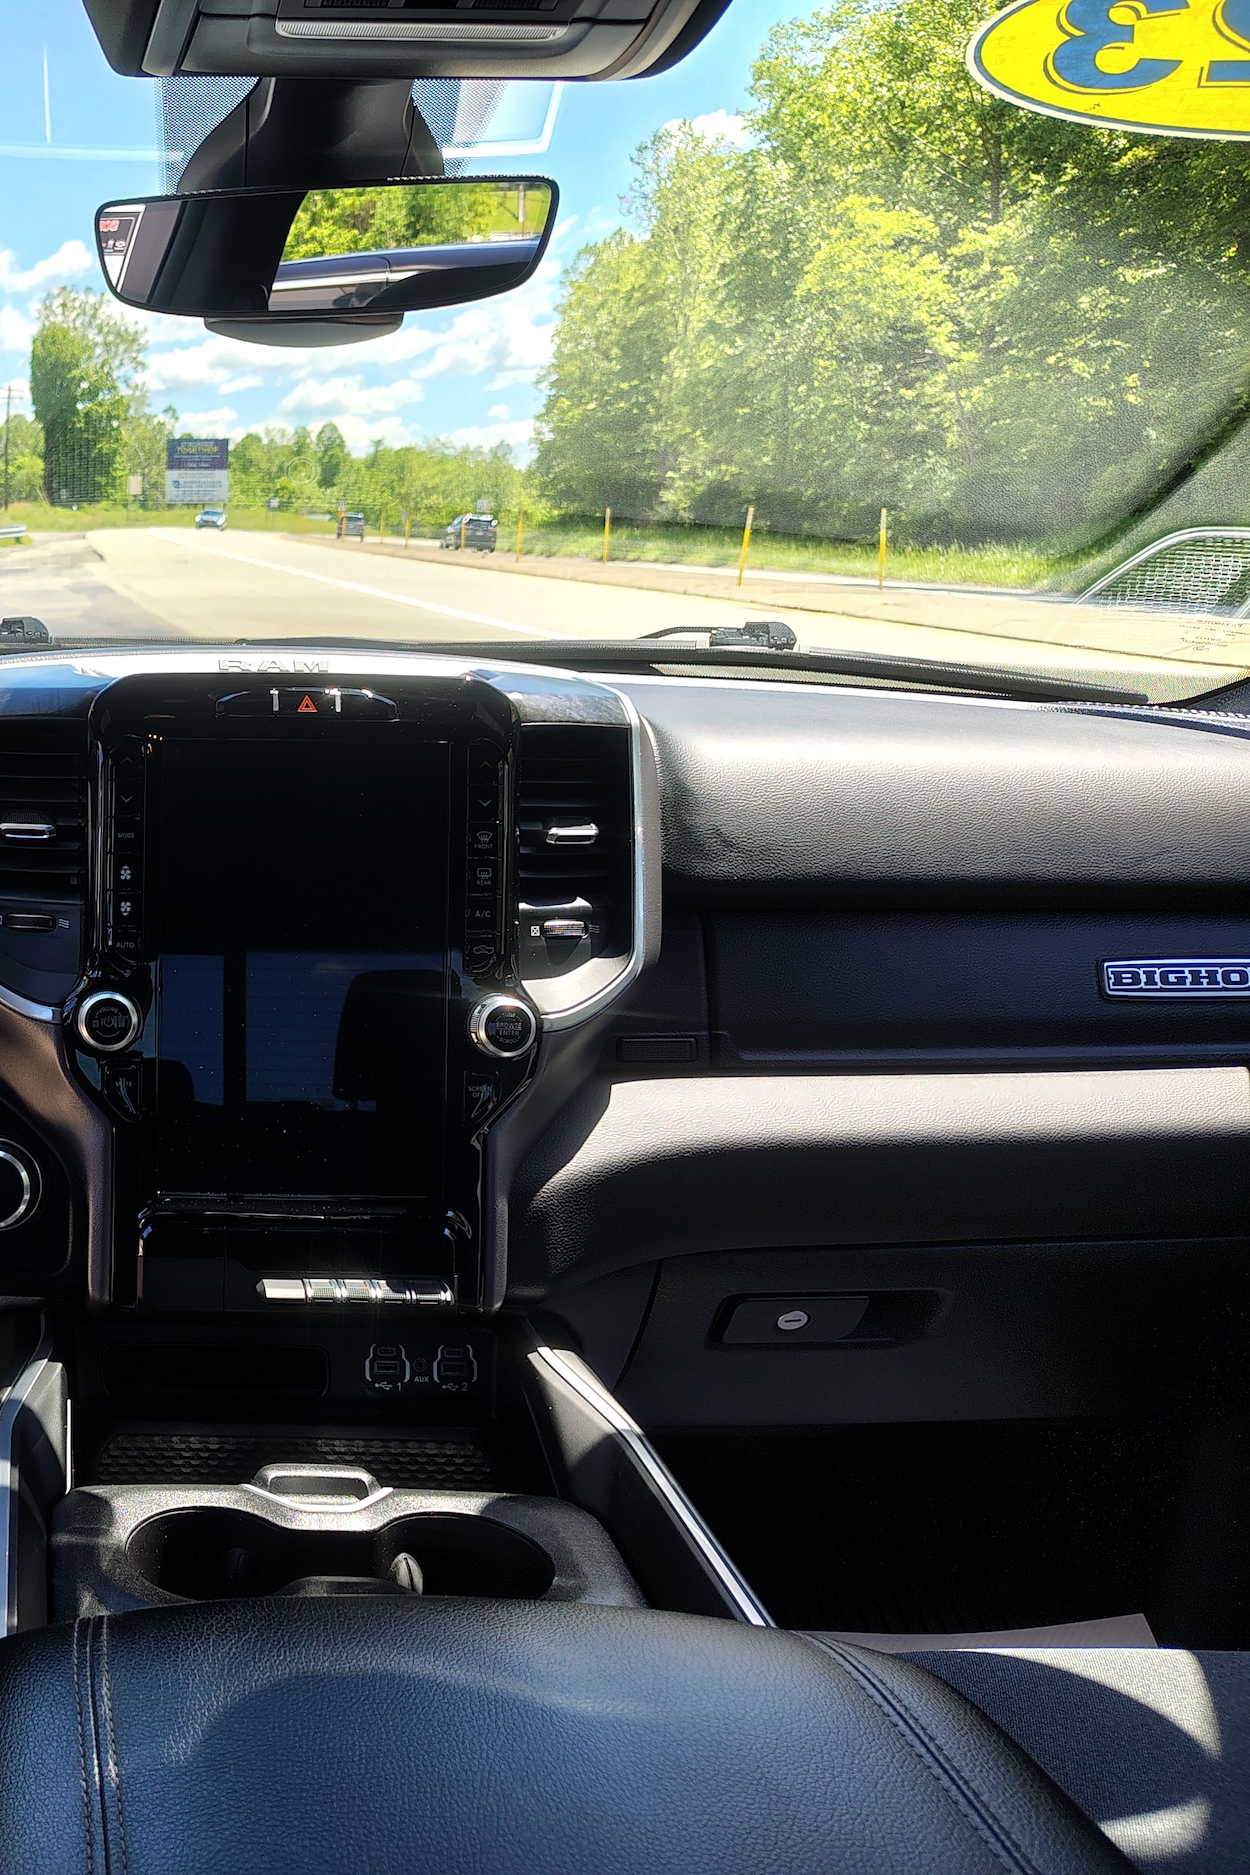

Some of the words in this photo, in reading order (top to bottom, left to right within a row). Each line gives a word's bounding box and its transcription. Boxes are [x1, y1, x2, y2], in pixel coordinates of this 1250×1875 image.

[218, 659, 330, 673] RAM
[474, 909, 492, 918] A/C
[116, 941, 135, 949] AUTO
[1107, 967, 1250, 989] BIGHO
[413, 1375, 430, 1383] AUX
